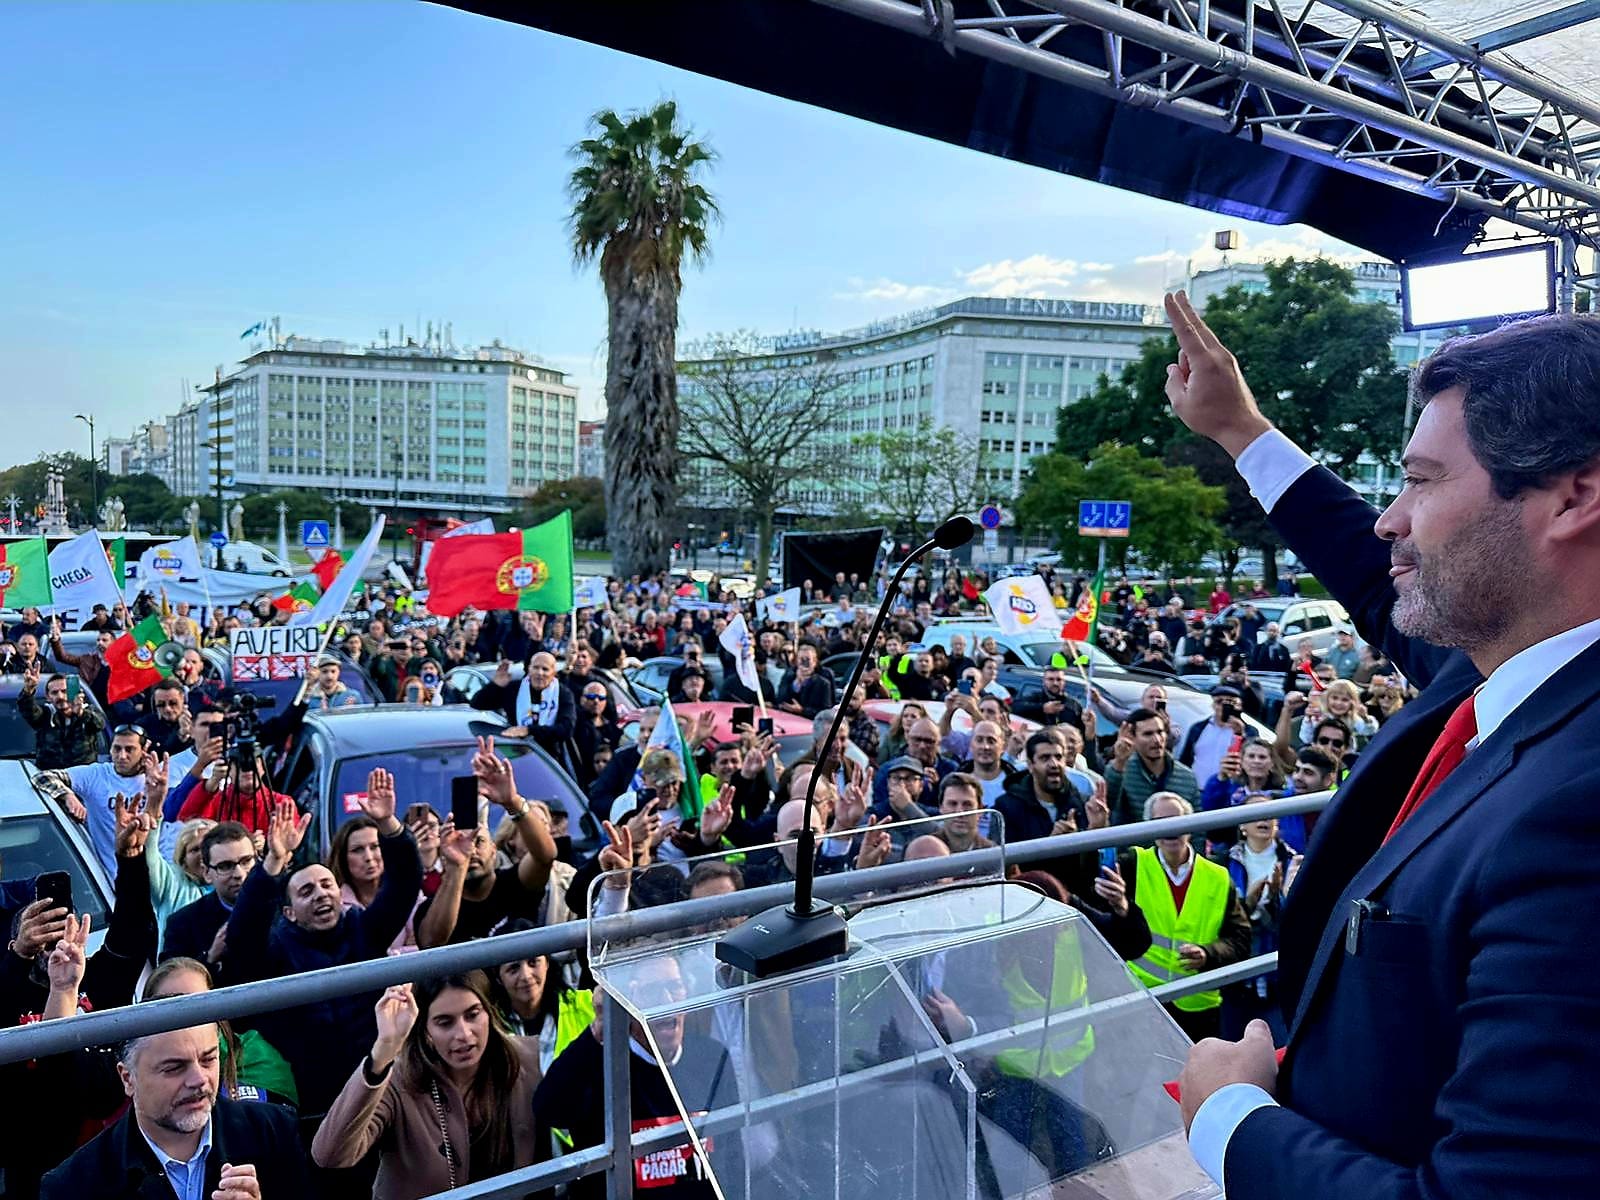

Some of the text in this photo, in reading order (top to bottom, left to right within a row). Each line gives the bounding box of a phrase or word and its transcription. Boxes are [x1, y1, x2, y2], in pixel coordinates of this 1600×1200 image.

[1005, 298, 1163, 320] FENIX LISBO
[51, 567, 92, 589] CHEGA
[233, 627, 319, 655] AVEIRO
[640, 1158, 687, 1181] PAGAR
